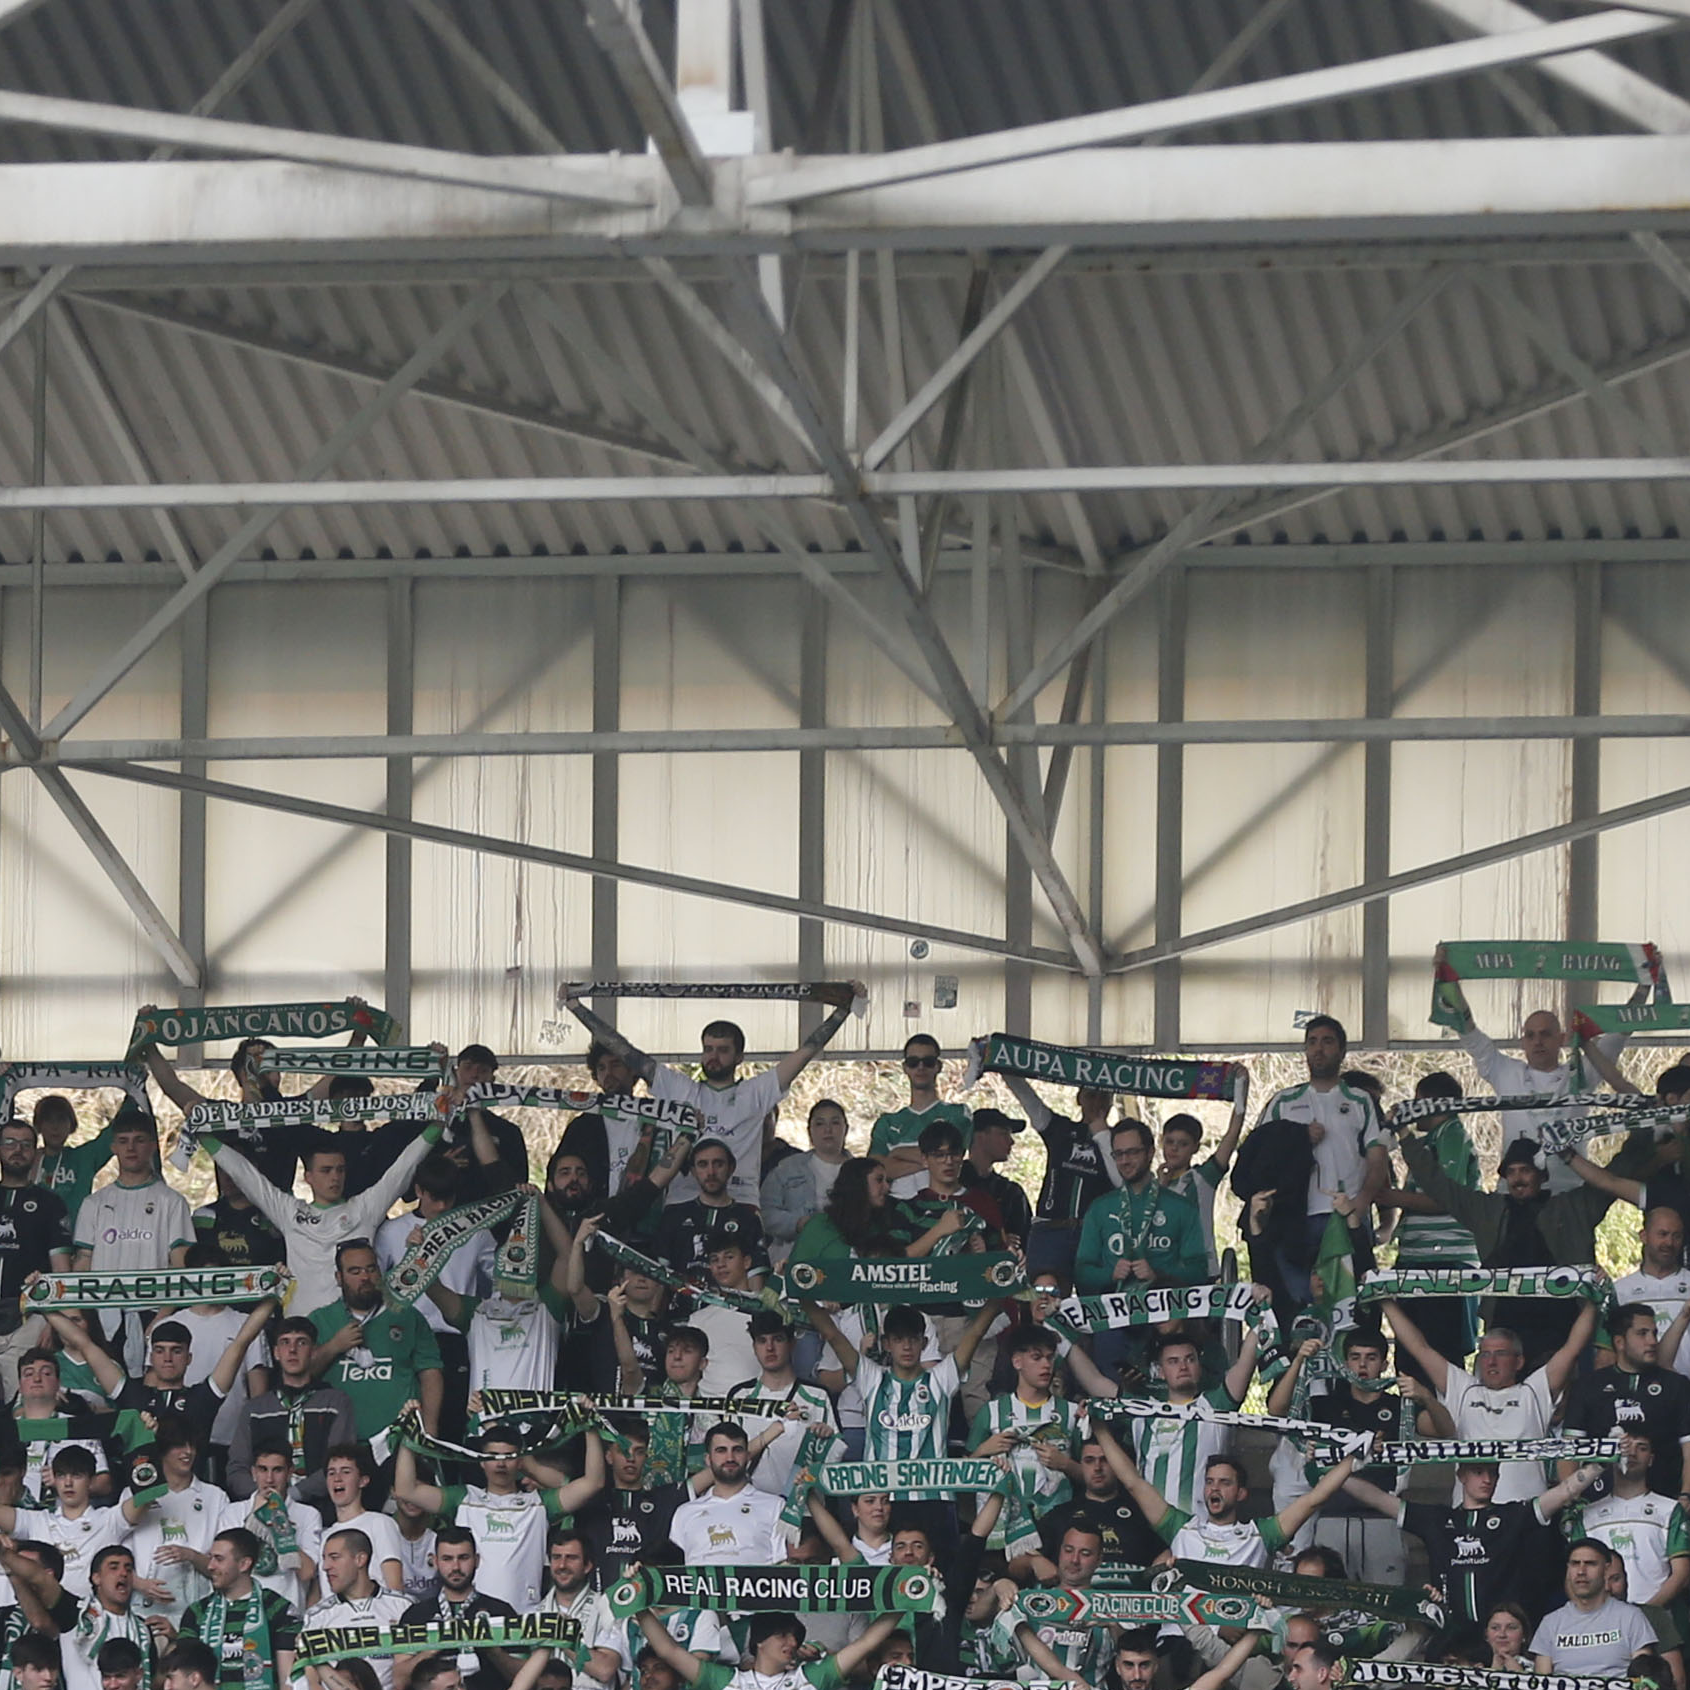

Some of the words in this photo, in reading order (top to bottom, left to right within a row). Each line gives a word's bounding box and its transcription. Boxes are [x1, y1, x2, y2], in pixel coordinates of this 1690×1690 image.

[1475, 954, 1515, 969] AUPA
[1561, 953, 1621, 971] RACING
[1618, 1007, 1659, 1023] AUPA
[274, 1050, 431, 1070] RACING
[993, 1040, 1065, 1079] AUPA
[1075, 1057, 1187, 1094] RACING
[191, 1103, 221, 1126] DE
[228, 1100, 311, 1120] PADRES
[316, 1098, 334, 1117] A
[340, 1095, 410, 1115] HIJOS
[599, 1093, 702, 1128] EMPRE
[118, 1228, 153, 1241] aldro
[422, 1221, 467, 1259] REAL
[851, 1264, 932, 1283] AMSTEL
[77, 1273, 235, 1300] RACING
[919, 1279, 959, 1294] Racing
[1052, 1298, 1111, 1331] REAL
[1110, 1288, 1203, 1318] RACING
[1208, 1285, 1263, 1318] CLUB
[895, 1414, 931, 1430] aldro
[827, 1465, 888, 1491] RACING
[898, 1461, 1000, 1491] SANTANDER
[1450, 1555, 1491, 1567] plenitude
[666, 1575, 719, 1597] REAL
[726, 1577, 808, 1599] RACING
[815, 1581, 871, 1598] CLUB
[1092, 1596, 1142, 1615] RACING
[1144, 1598, 1180, 1615] CLUB
[392, 1623, 429, 1644] DE
[438, 1617, 493, 1643] UNA
[504, 1611, 583, 1643] PASIO
